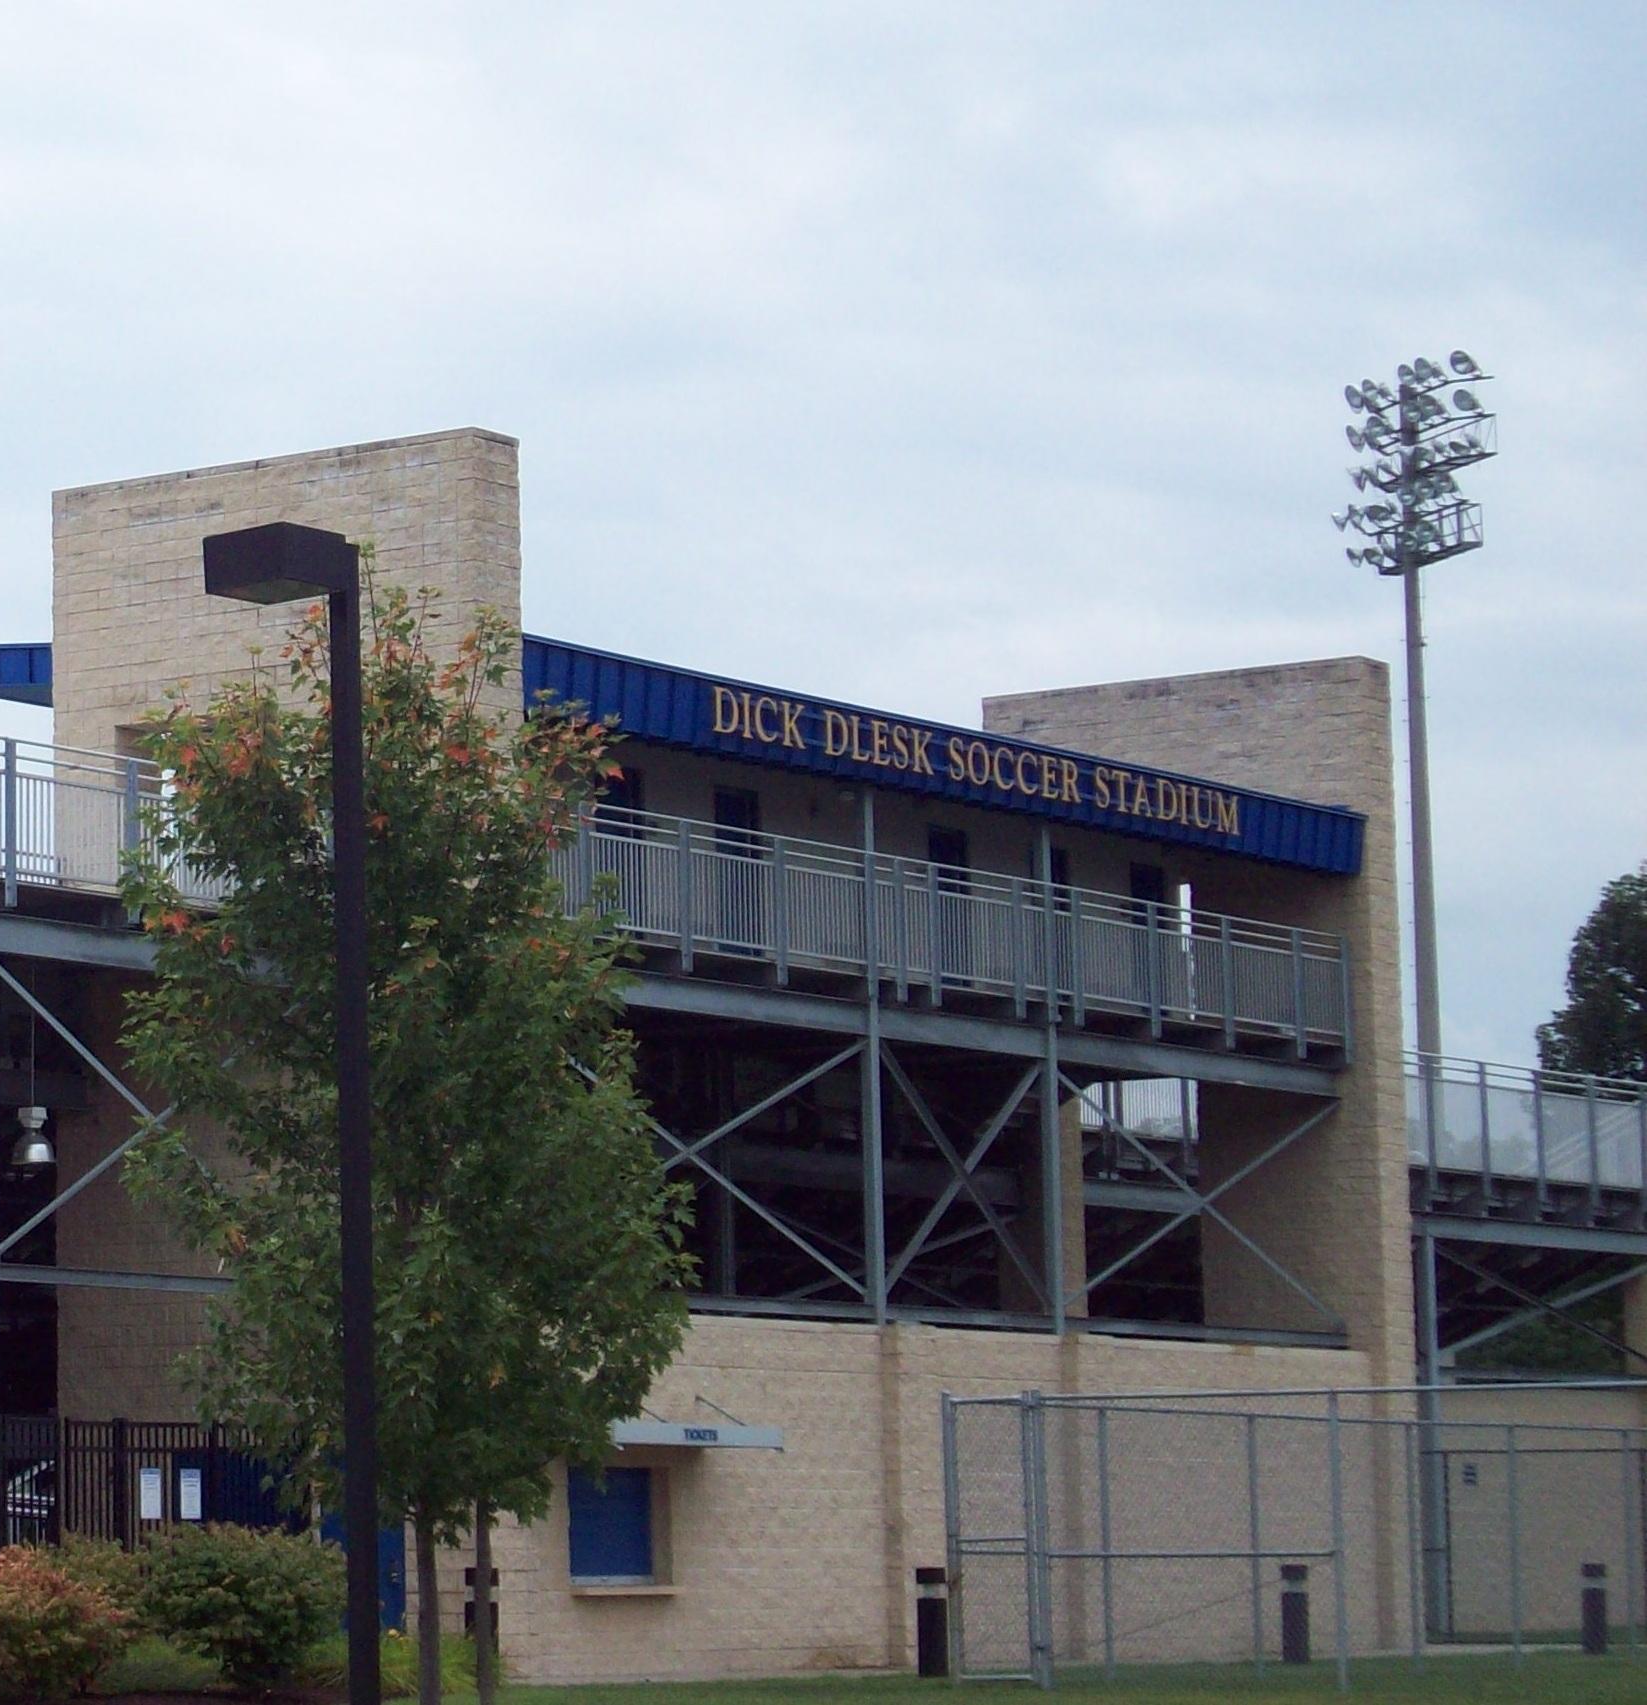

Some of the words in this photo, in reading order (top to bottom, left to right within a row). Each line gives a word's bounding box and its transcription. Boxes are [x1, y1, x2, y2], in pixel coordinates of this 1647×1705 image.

[712, 684, 807, 751] DICK
[824, 708, 935, 776] DLESK
[947, 735, 1083, 804] SOCCER
[1093, 766, 1242, 837] STADIUM
[683, 1428, 719, 1442] TICKETS
